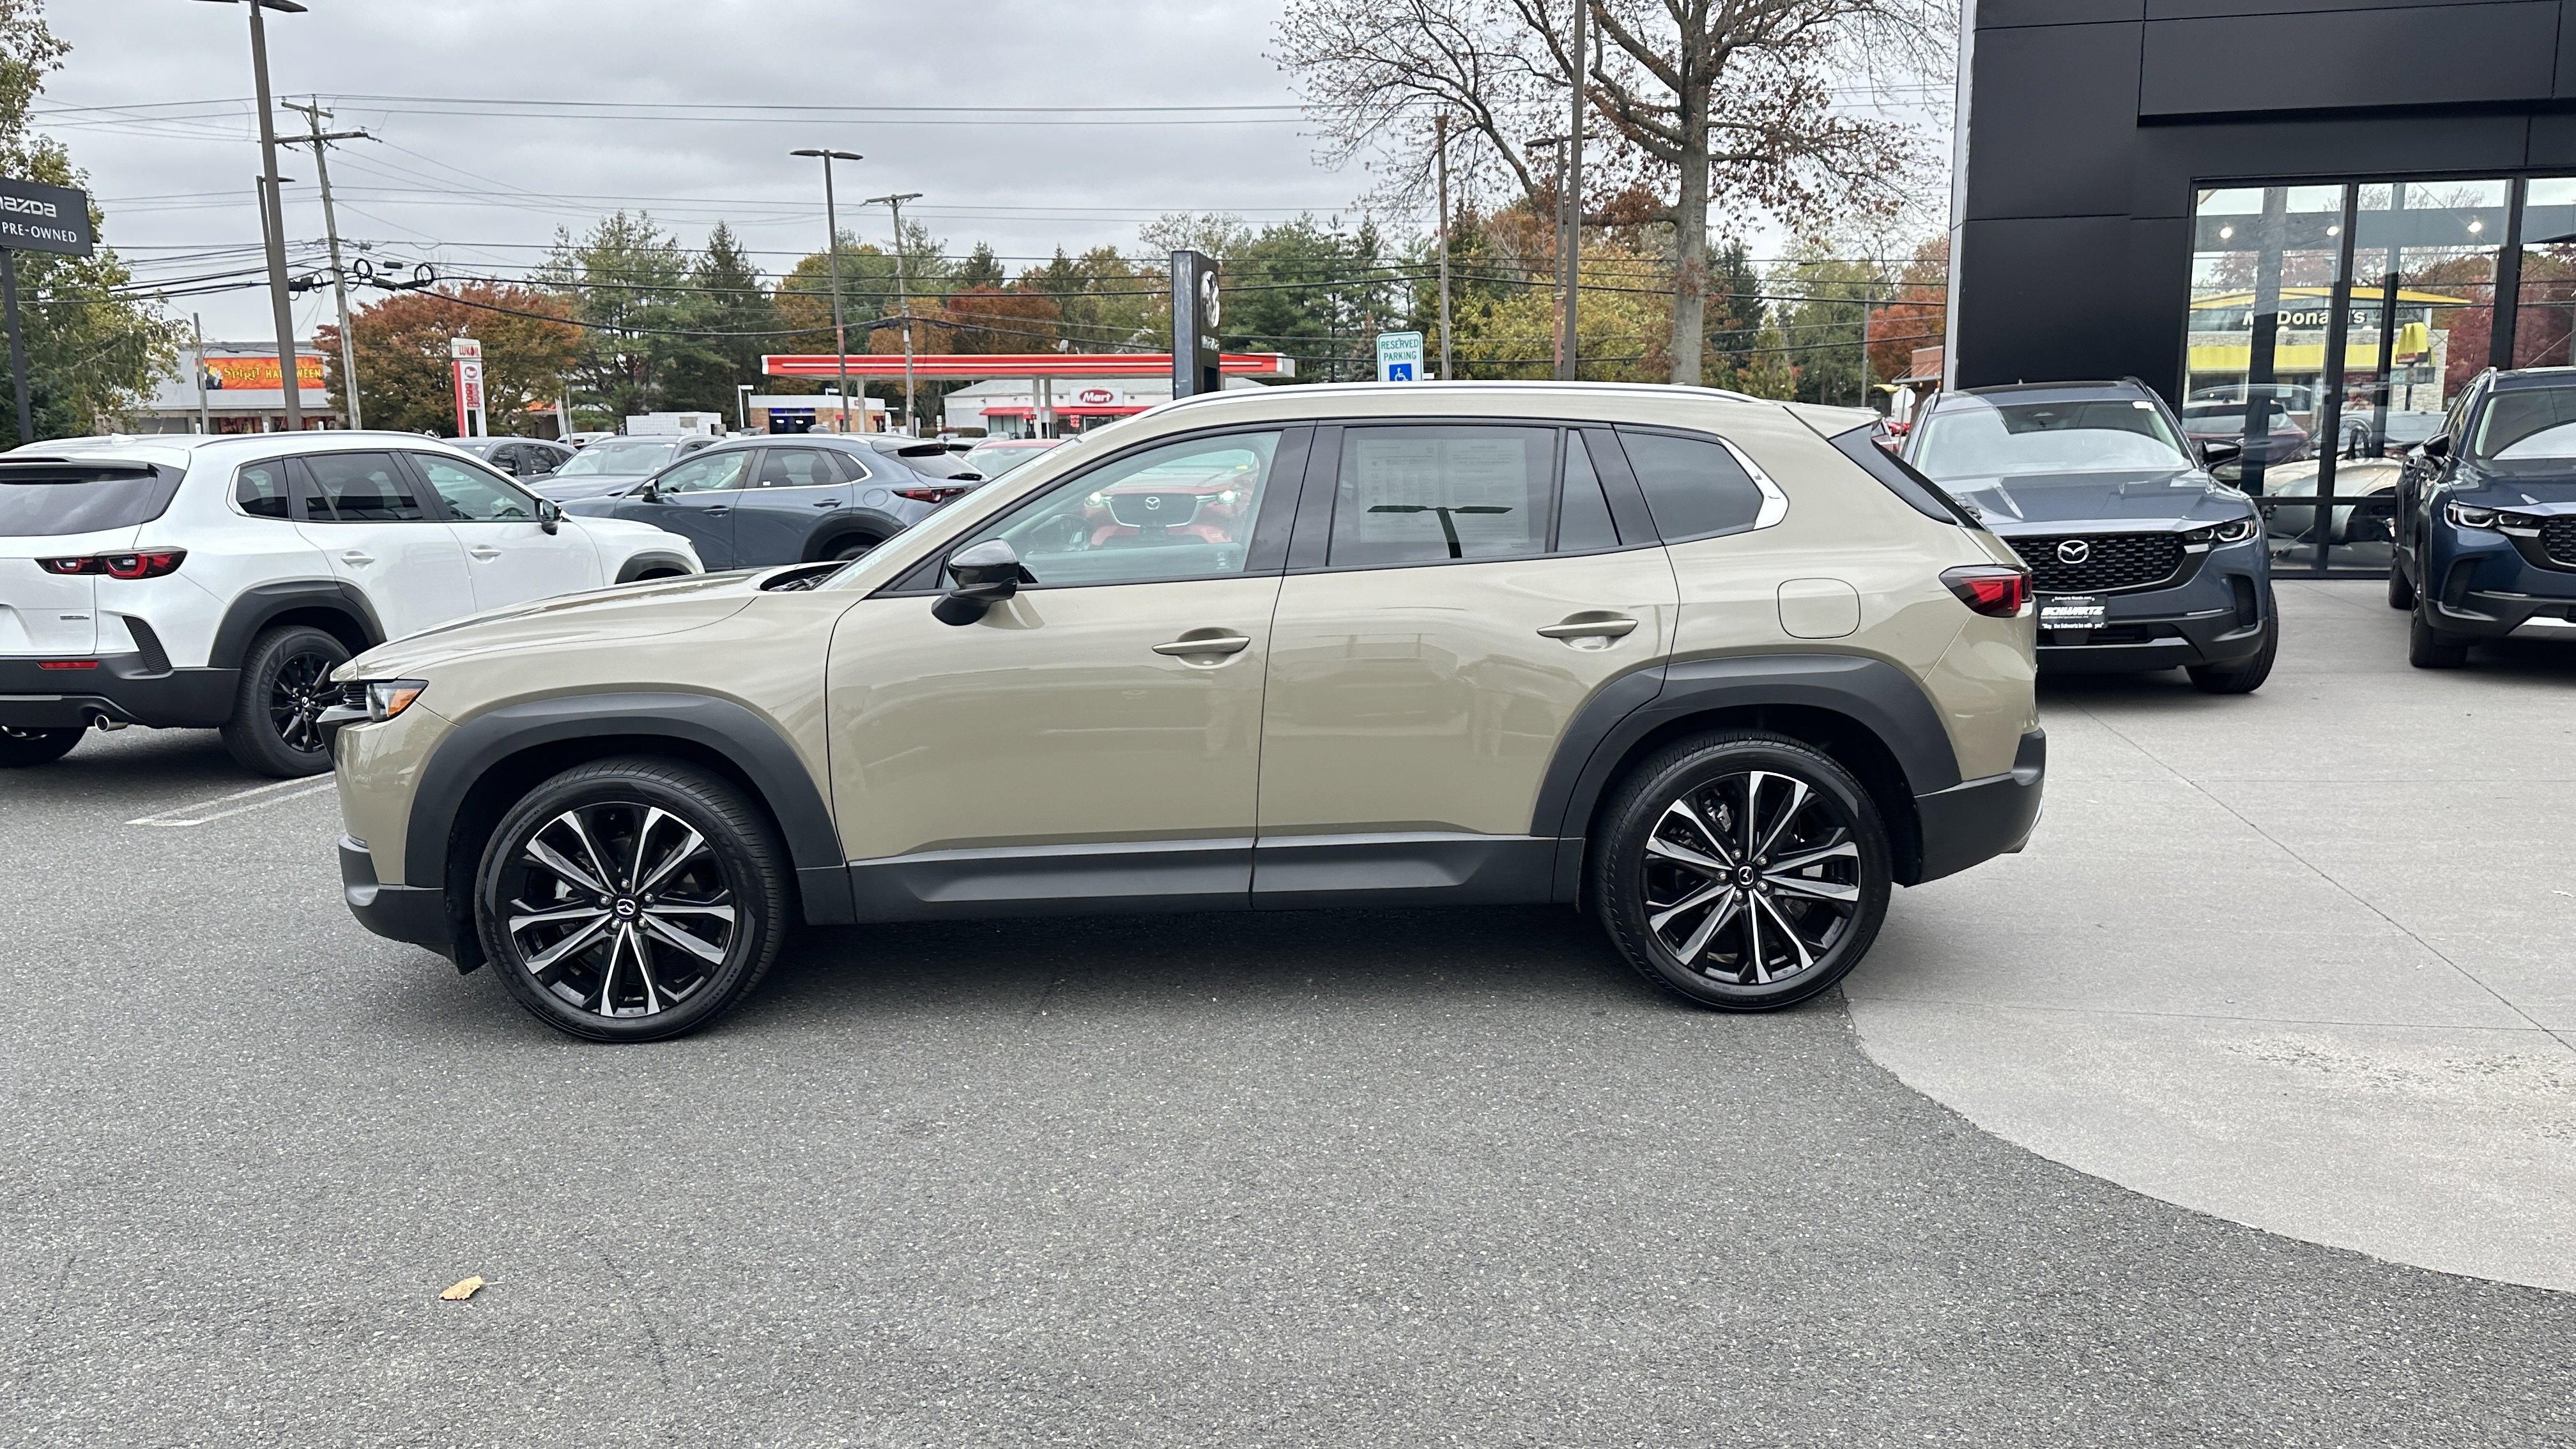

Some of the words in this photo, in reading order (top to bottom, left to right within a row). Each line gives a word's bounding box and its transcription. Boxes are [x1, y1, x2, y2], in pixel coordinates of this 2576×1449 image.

[2, 221, 77, 243] PRE-OWNED
[1381, 339, 1419, 349] RESERVED
[459, 345, 480, 356] LUKOIL
[1384, 351, 1416, 362] PARKING
[224, 366, 262, 381] SPIRIT
[265, 368, 321, 379] HALWEEN
[1082, 392, 1111, 402] Mart
[2041, 606, 2105, 616] SCHWARTZ
